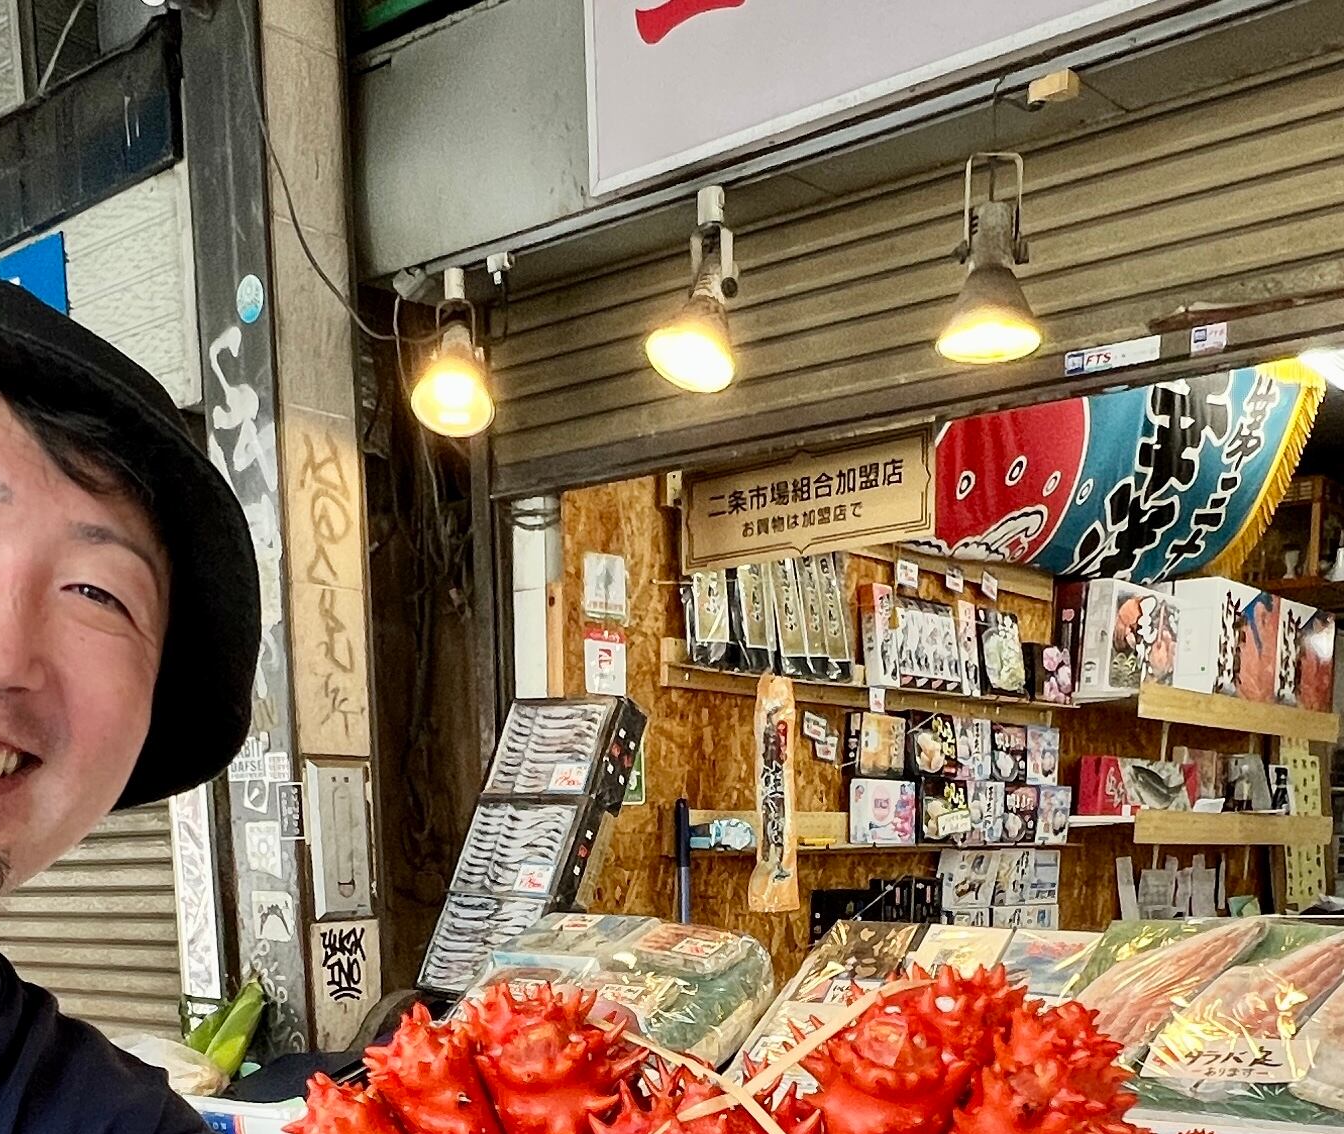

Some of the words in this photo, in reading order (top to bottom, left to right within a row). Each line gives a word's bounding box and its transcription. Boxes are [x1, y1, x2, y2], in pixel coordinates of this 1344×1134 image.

[1086, 352, 1112, 366] FTS
[707, 458, 905, 518] 二条市場組合加盟店
[742, 501, 863, 538] お買物は加盟店で
